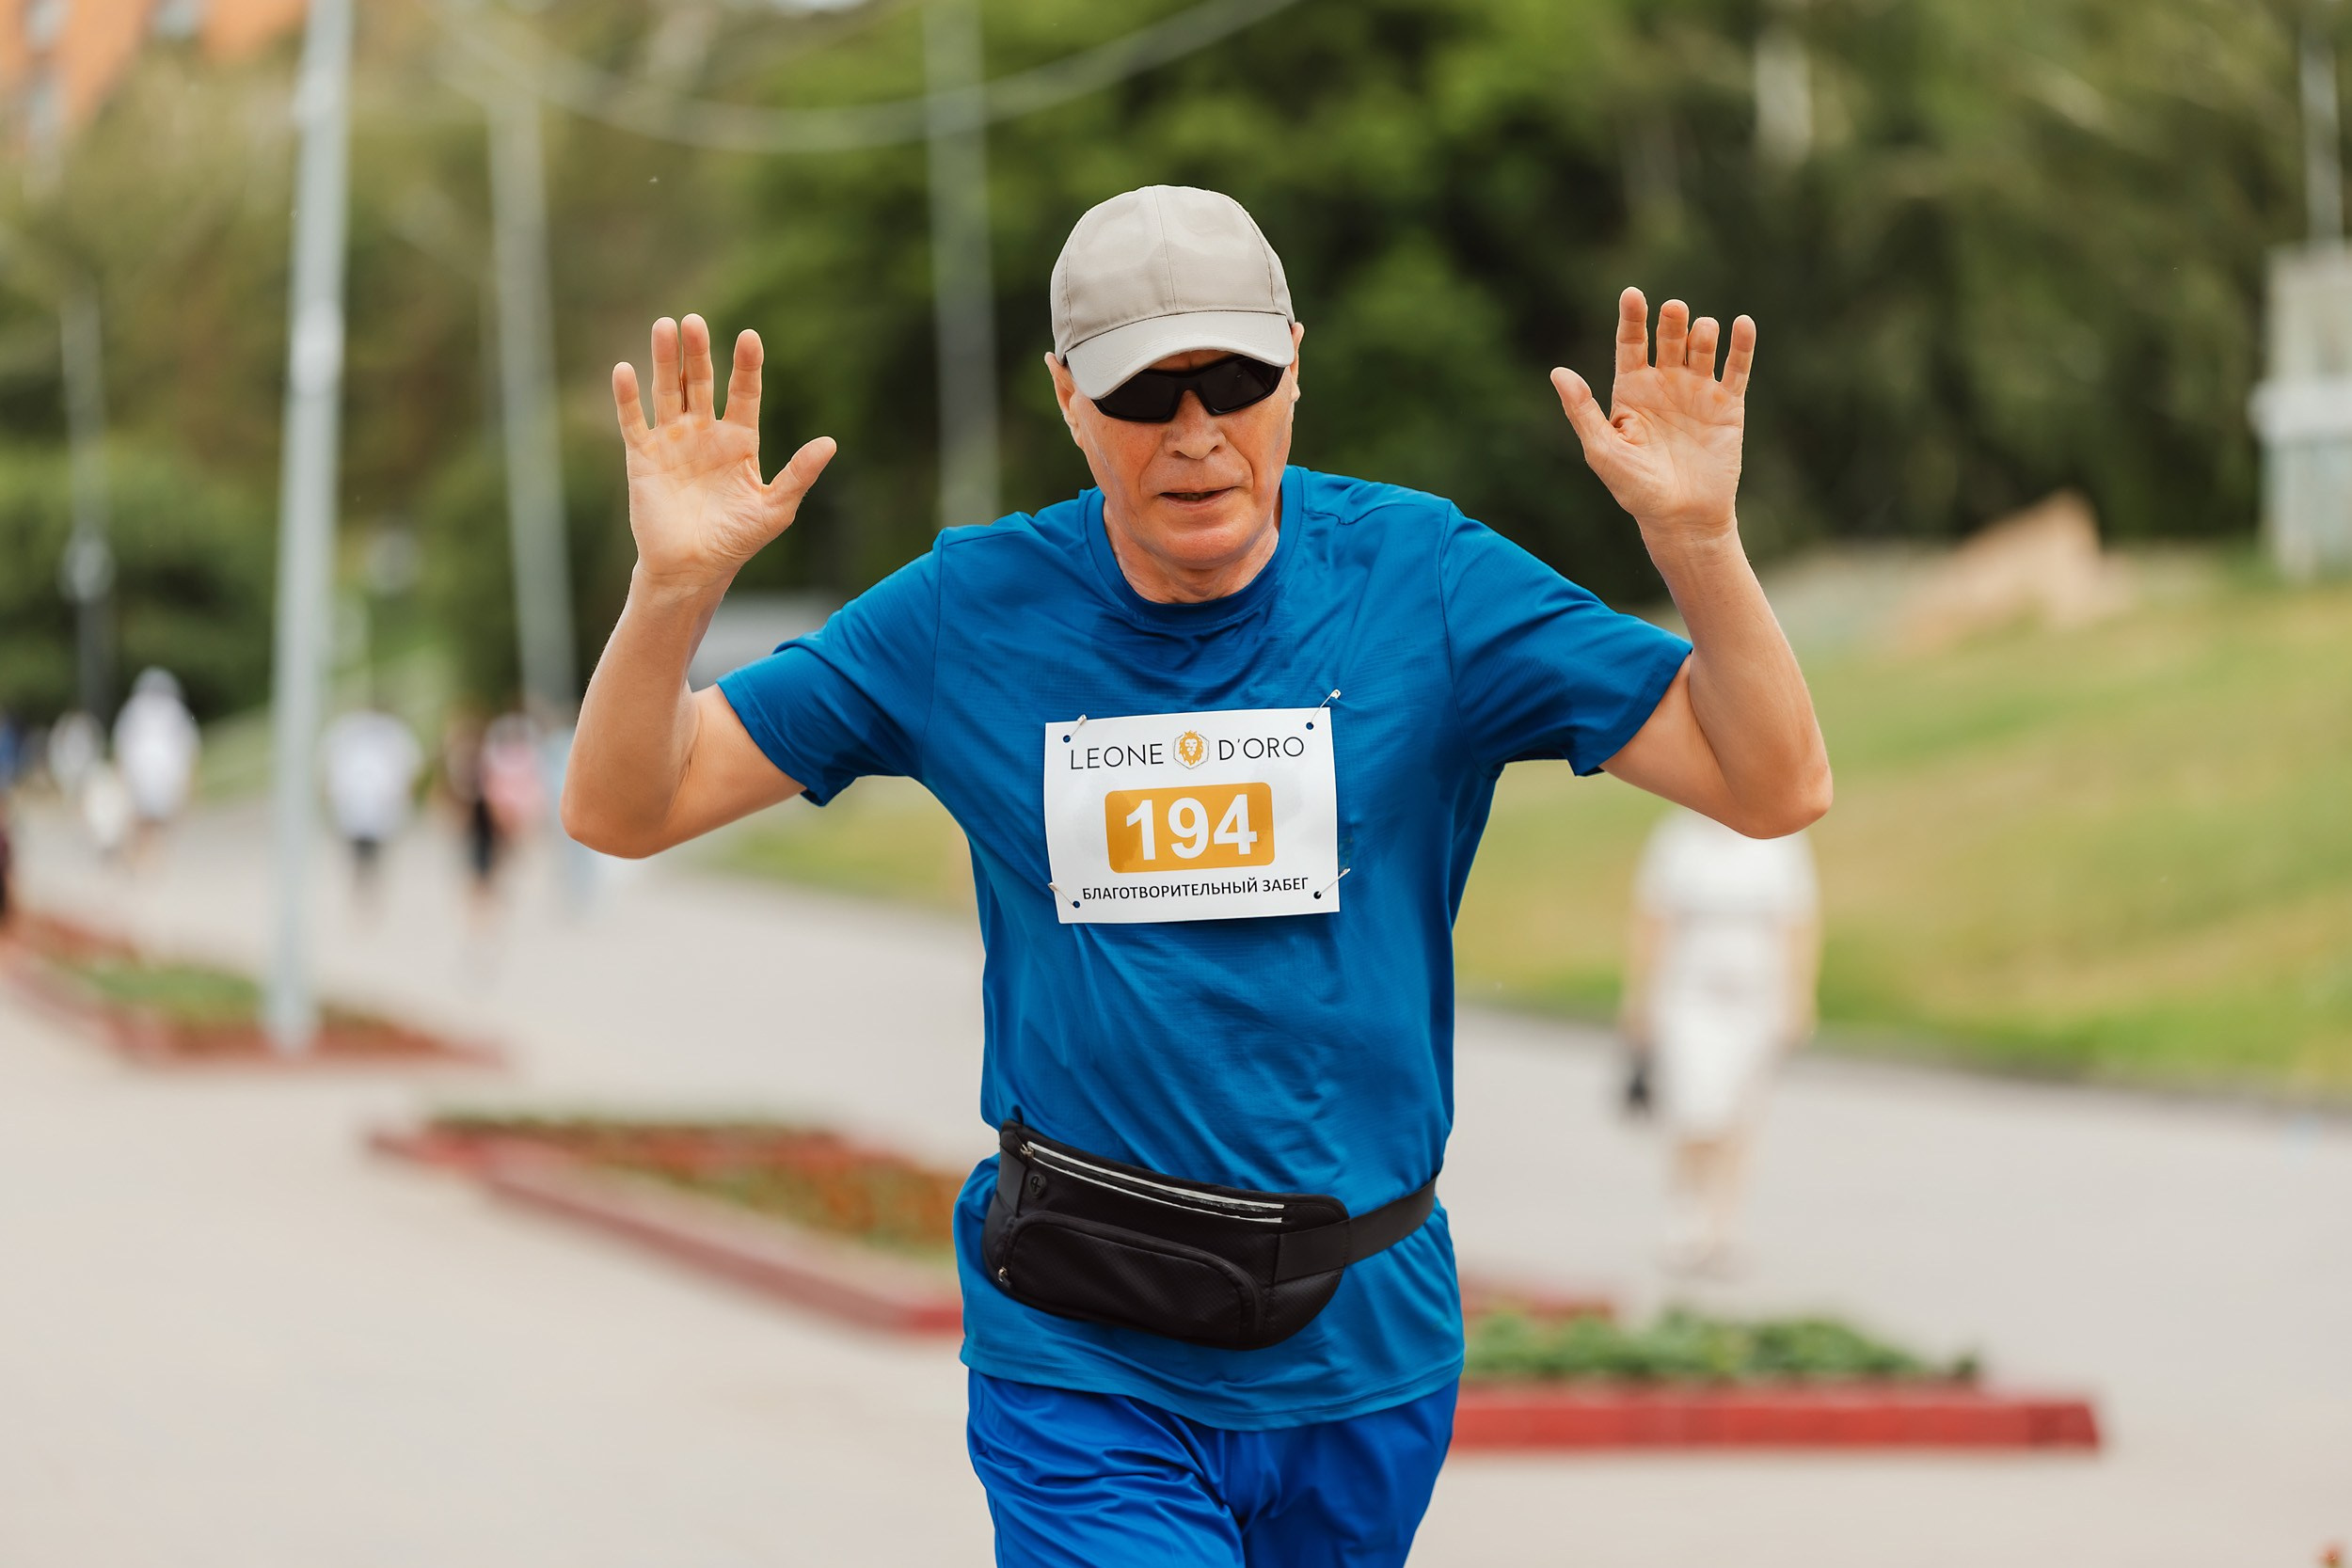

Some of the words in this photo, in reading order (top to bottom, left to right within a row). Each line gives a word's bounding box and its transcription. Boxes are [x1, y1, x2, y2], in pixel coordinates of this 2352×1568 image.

[1070, 743, 1165, 770] LEONE
[1125, 793, 1258, 861] 194
[1082, 877, 1258, 900] БЛАГОТВОРИТЕЛЬНЫЙ
[1262, 877, 1309, 893] ЗАБЕГ
